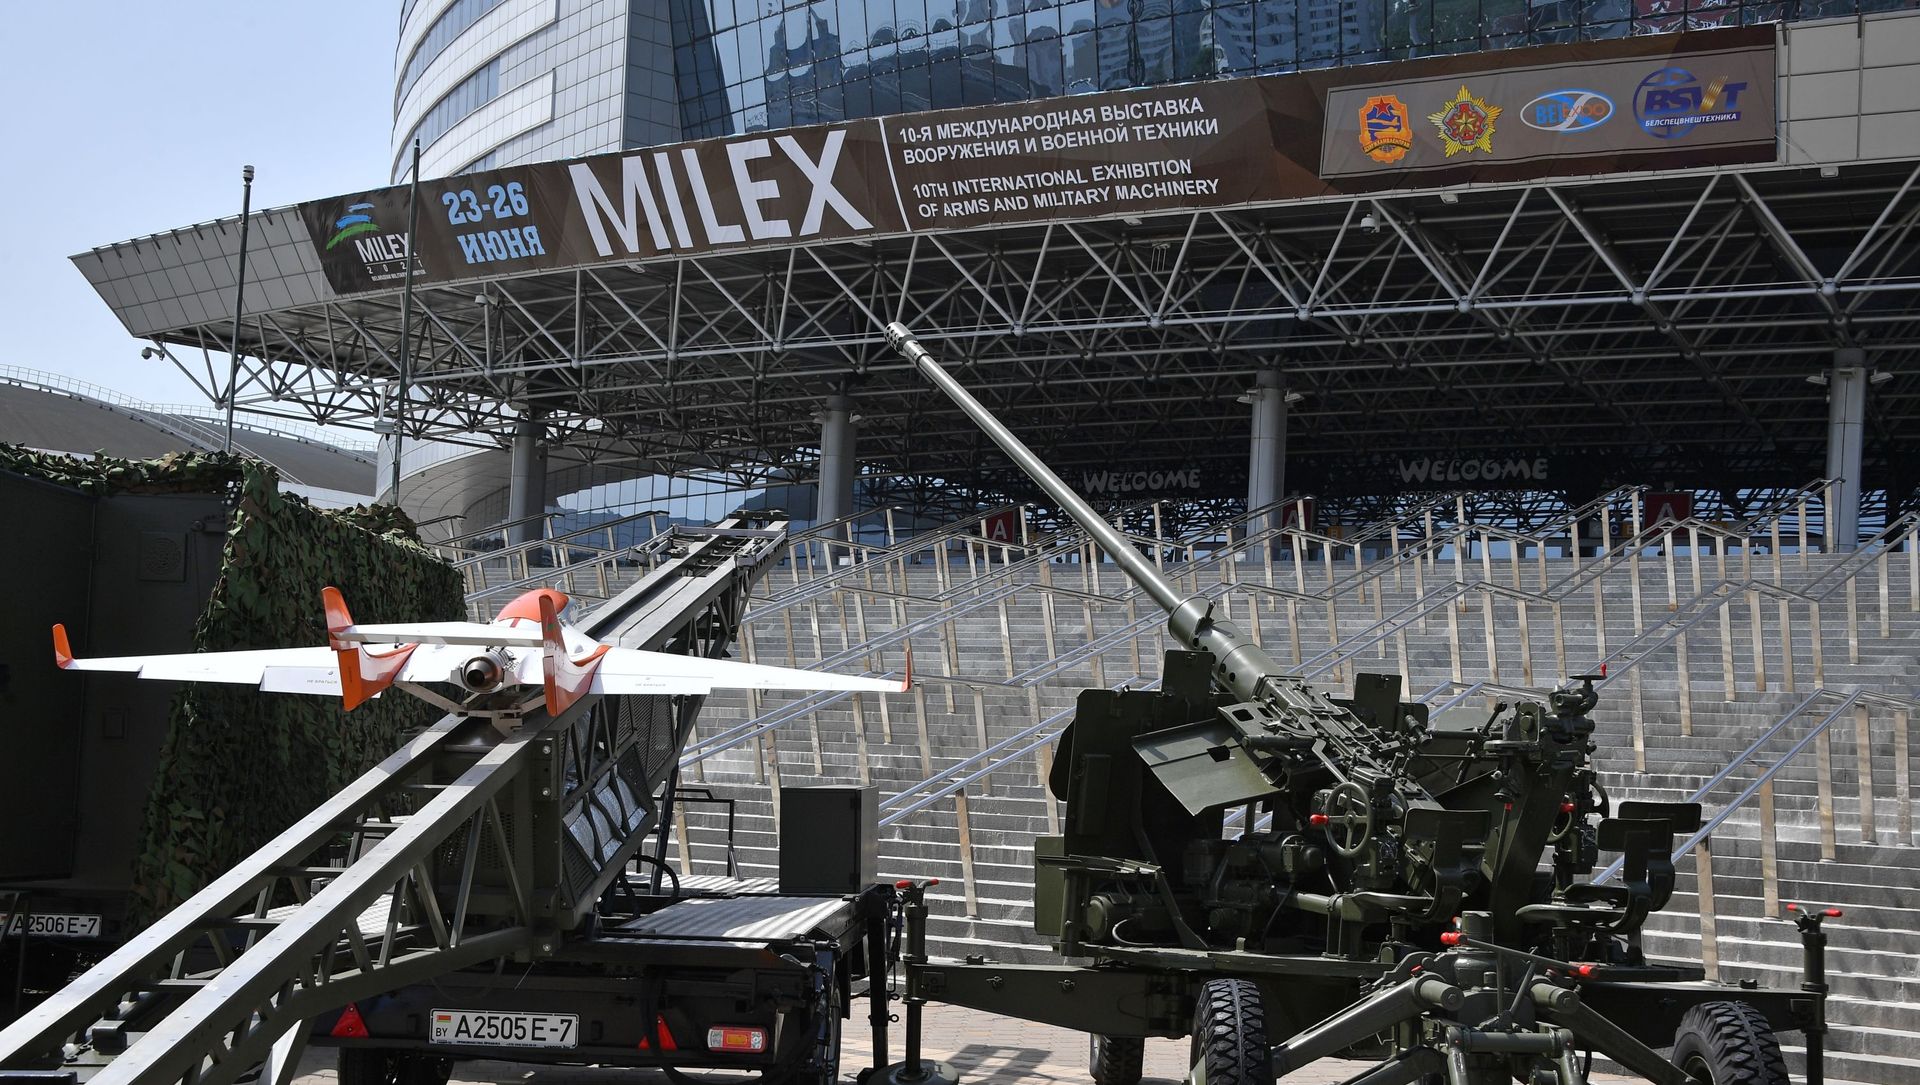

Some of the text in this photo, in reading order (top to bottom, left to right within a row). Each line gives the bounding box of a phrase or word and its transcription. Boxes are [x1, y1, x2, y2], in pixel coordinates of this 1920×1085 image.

[900, 96, 1204, 143] 10-Я МЕЖДУНАРОДНАЯ ВЫСТАВКА
[1645, 113, 1737, 127] БЕЛСПЕЦВНЕШТЕХНИКА
[903, 118, 1219, 165] ВООРУЖЕНИЯ И ВОЕННОЙ ТЕХНИКИ
[567, 130, 874, 257] MILEX
[912, 158, 1193, 199] 10TH INTERNATIONAL EXHIBITION
[918, 178, 1220, 218] OF ARMS AND MILITARY MACHINERY
[442, 181, 530, 226] 23-26
[457, 225, 546, 264] ИЮНЯ
[1083, 469, 1201, 494] WELCOME
[1399, 457, 1549, 483] WELCOME
[992, 519, 1007, 539] A
[1656, 502, 1679, 523] A
[435, 1028, 448, 1037] BY
